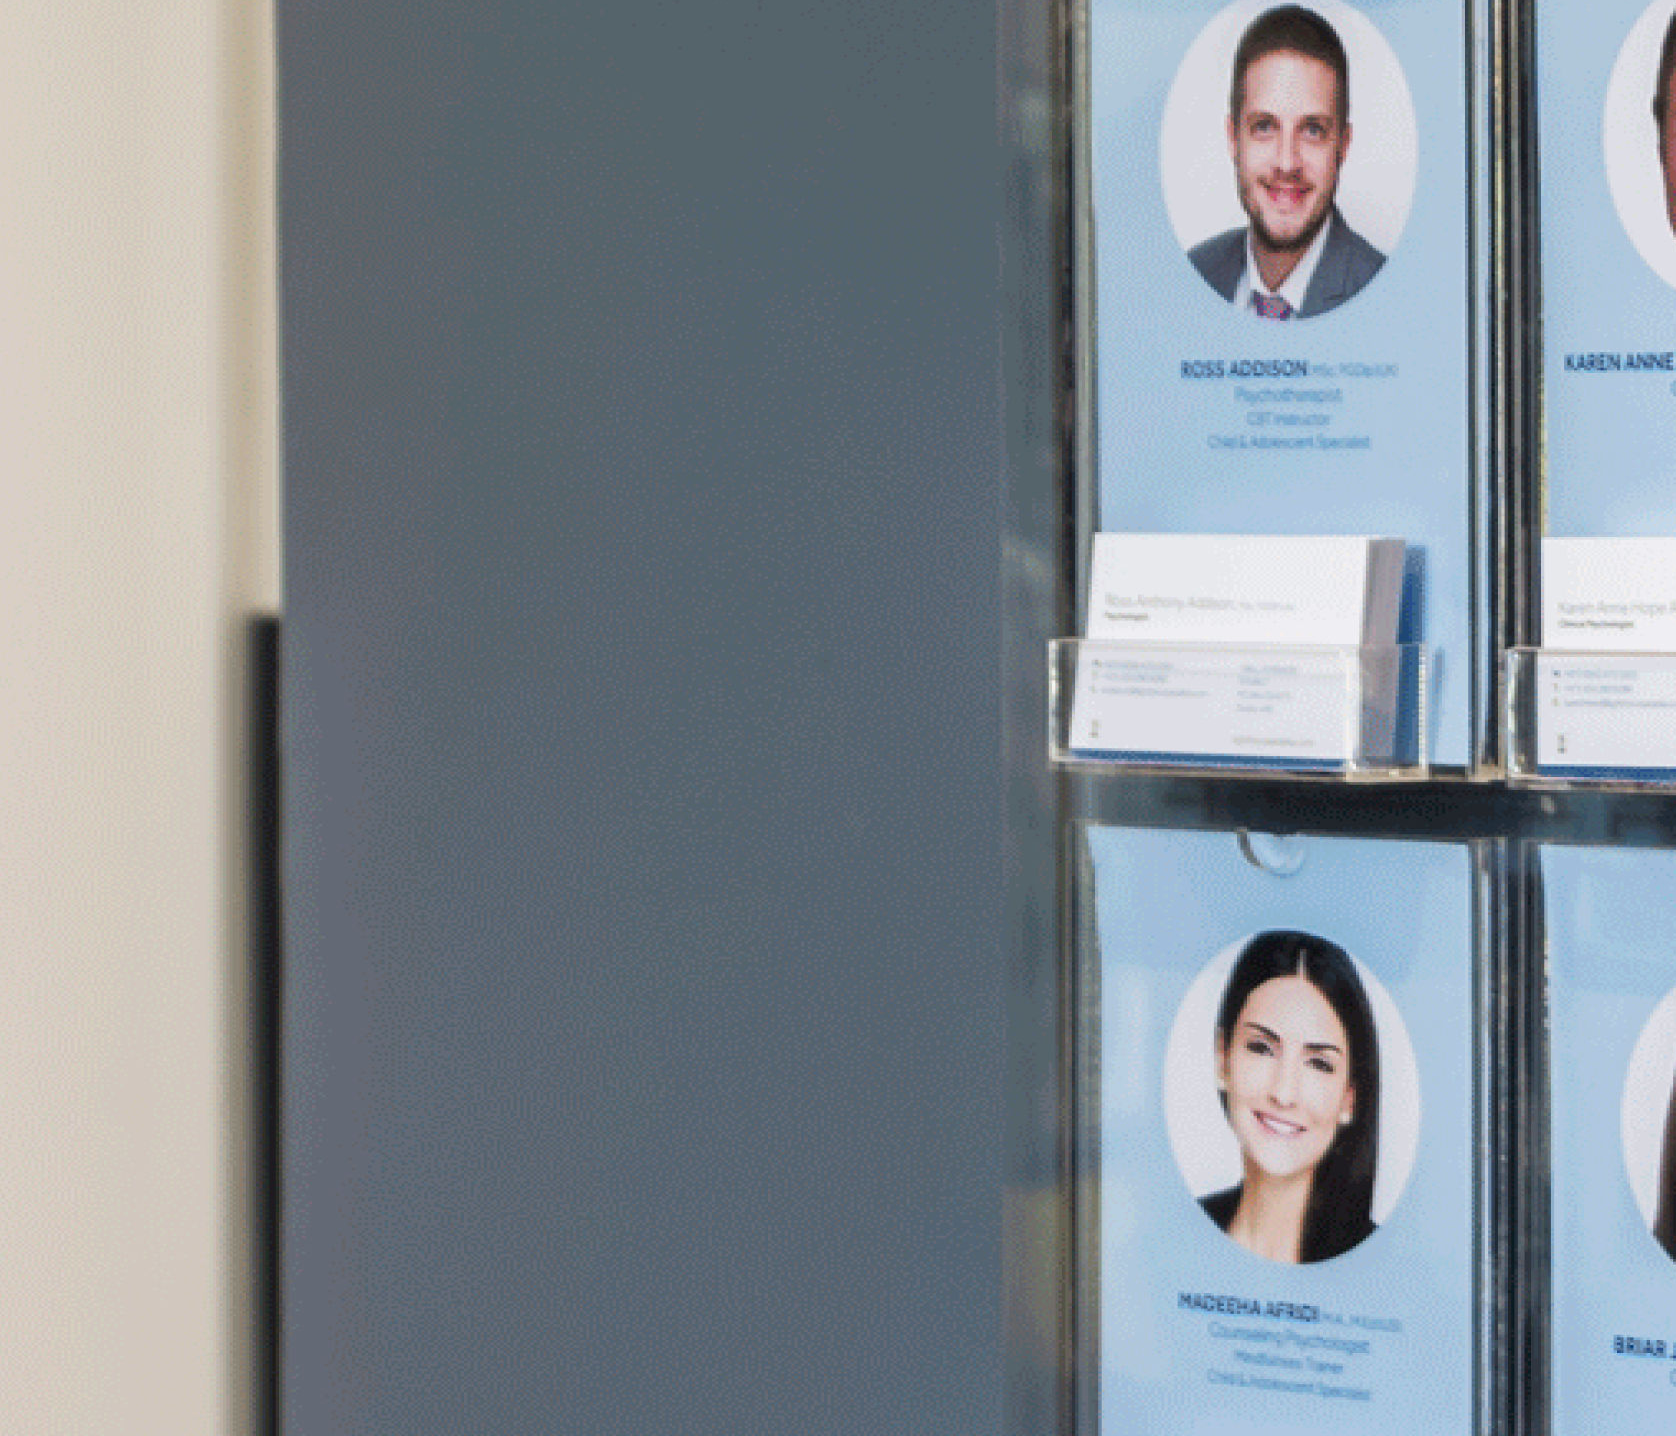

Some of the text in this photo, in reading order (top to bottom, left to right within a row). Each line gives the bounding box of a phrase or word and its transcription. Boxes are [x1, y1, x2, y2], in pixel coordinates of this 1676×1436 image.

[1180, 359, 1225, 378] ROSS
[1227, 359, 1311, 378] ADDISON
[1564, 352, 1621, 371] KAREN
[1624, 352, 1674, 370] ANNE
[1178, 1292, 1320, 1322] MADEEHA AFRIDI
[1613, 1335, 1667, 1358] BRIAR
